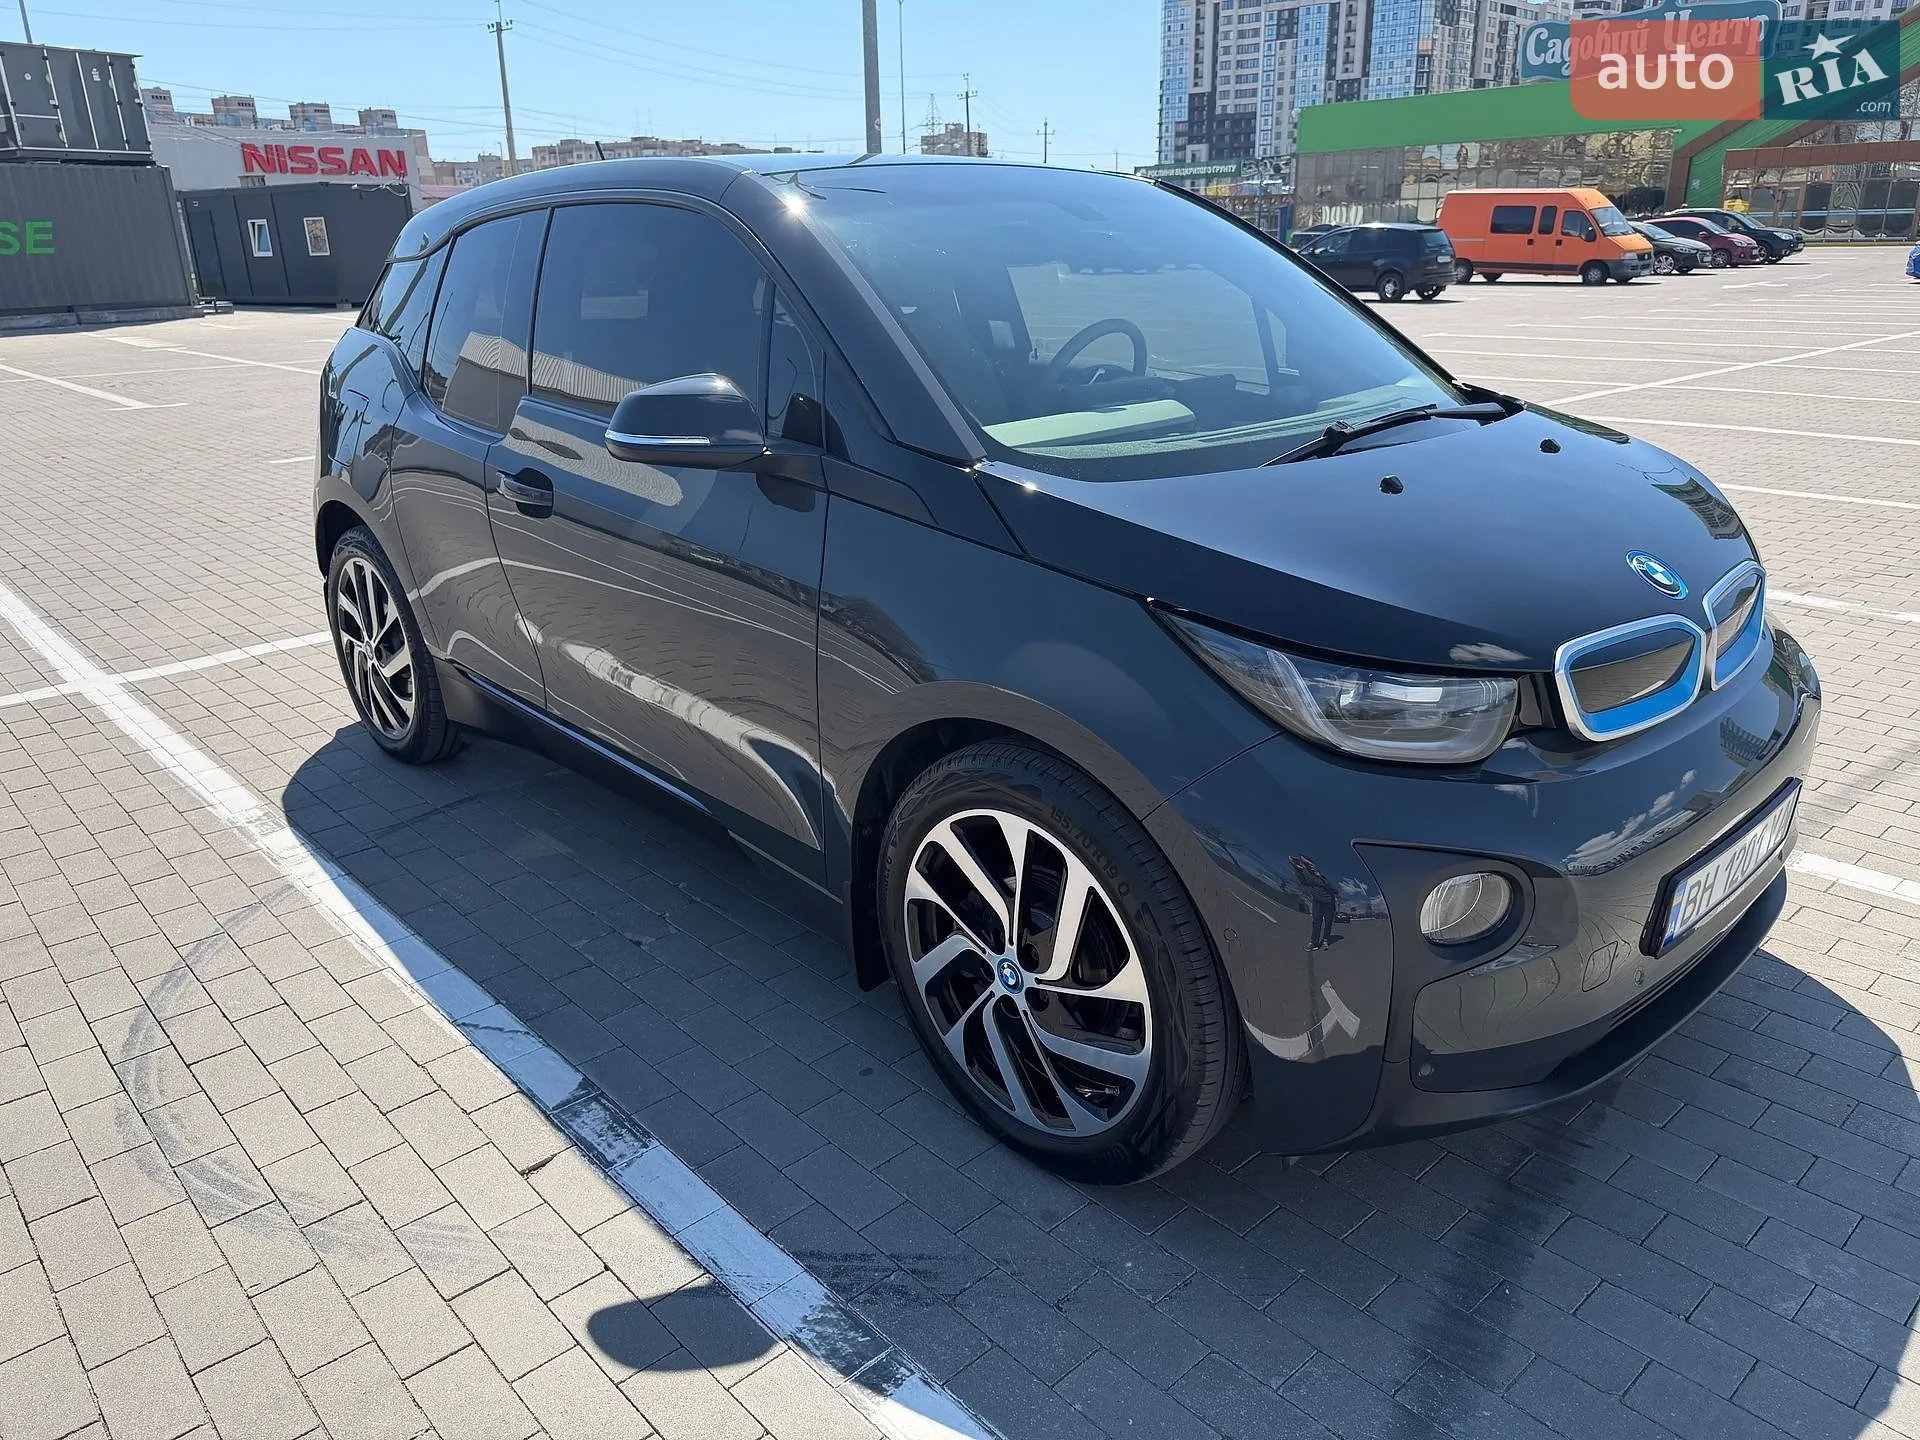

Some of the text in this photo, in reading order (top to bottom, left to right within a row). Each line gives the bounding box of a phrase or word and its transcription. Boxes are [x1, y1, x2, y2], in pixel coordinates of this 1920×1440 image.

[1526, 9, 1769, 73] Садовий Центр
[241, 143, 408, 177] NISSAN
[0, 221, 55, 256] SE
[1681, 864, 1720, 924] BH
[1723, 823, 1768, 894] 1201
